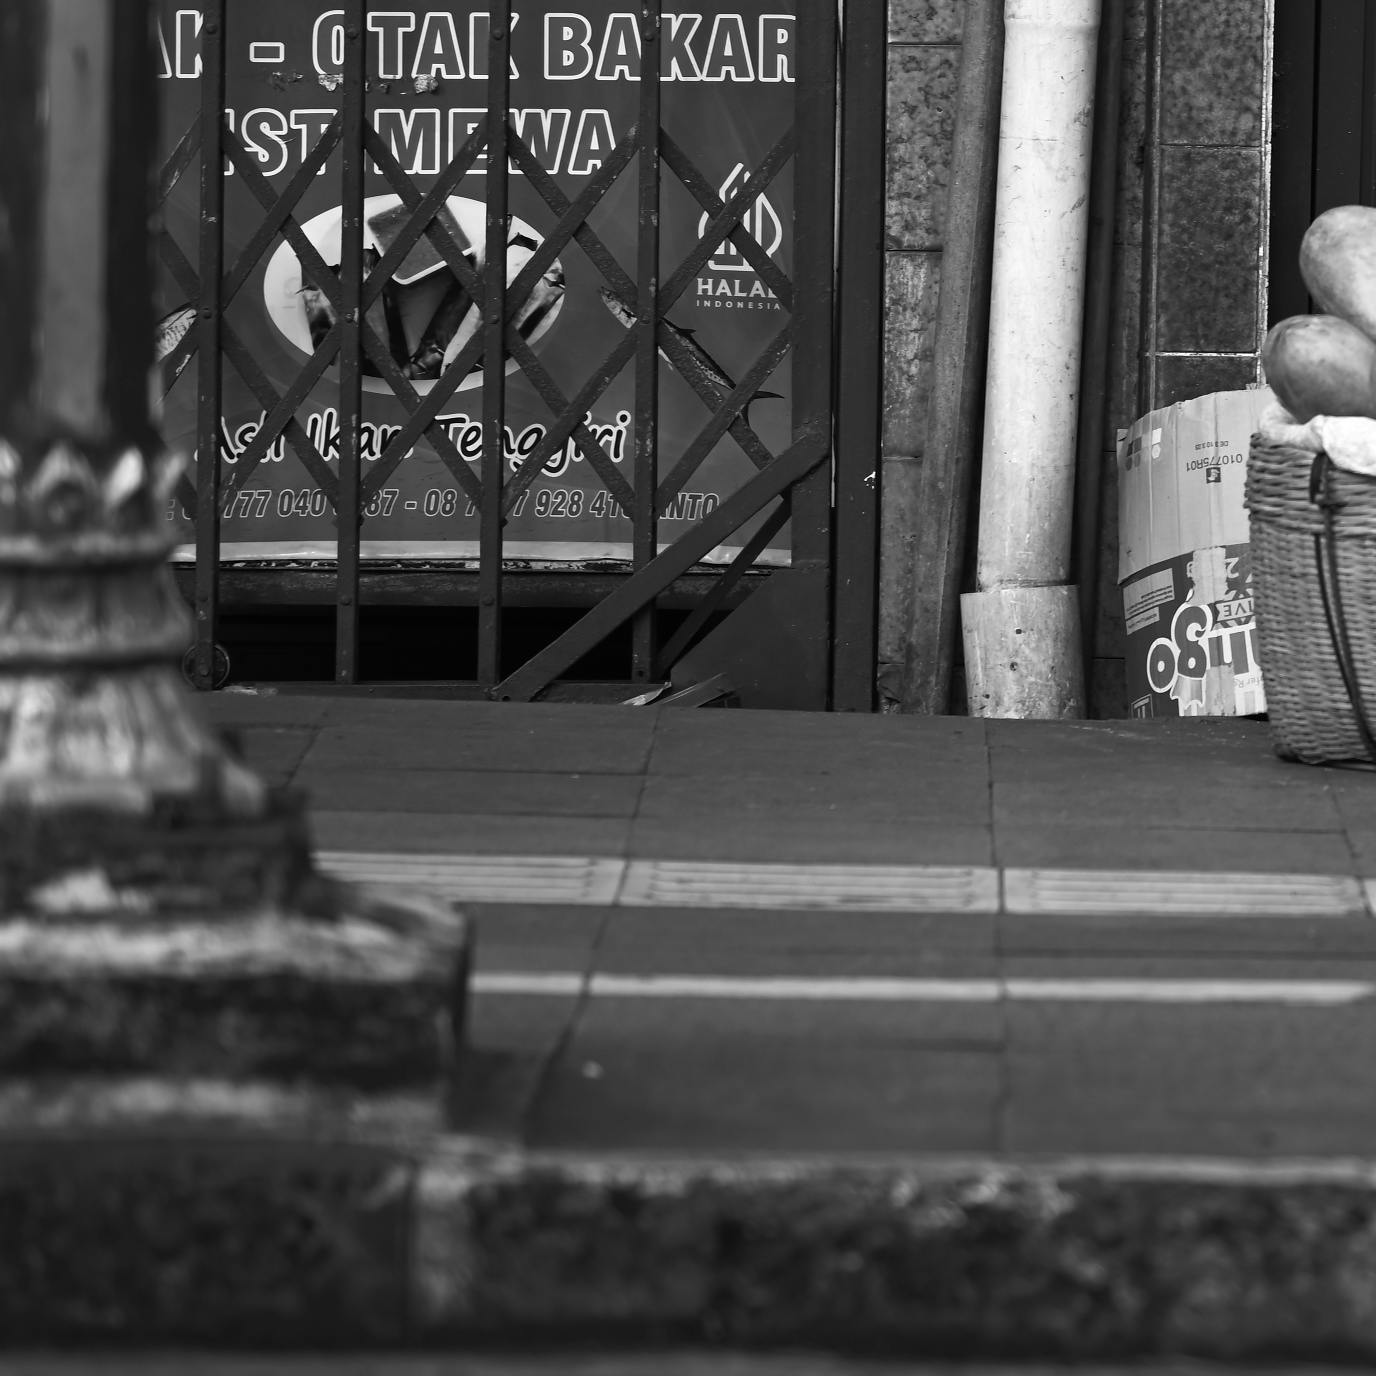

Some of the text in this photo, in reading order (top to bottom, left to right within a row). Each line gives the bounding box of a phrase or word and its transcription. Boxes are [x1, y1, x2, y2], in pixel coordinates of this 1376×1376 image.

[312, 9, 520, 80] OTAK
[543, 12, 797, 82] BAKAR
[224, 107, 617, 176] STMEWA
[696, 299, 781, 311] INDONESIA
[535, 490, 584, 517] 928
